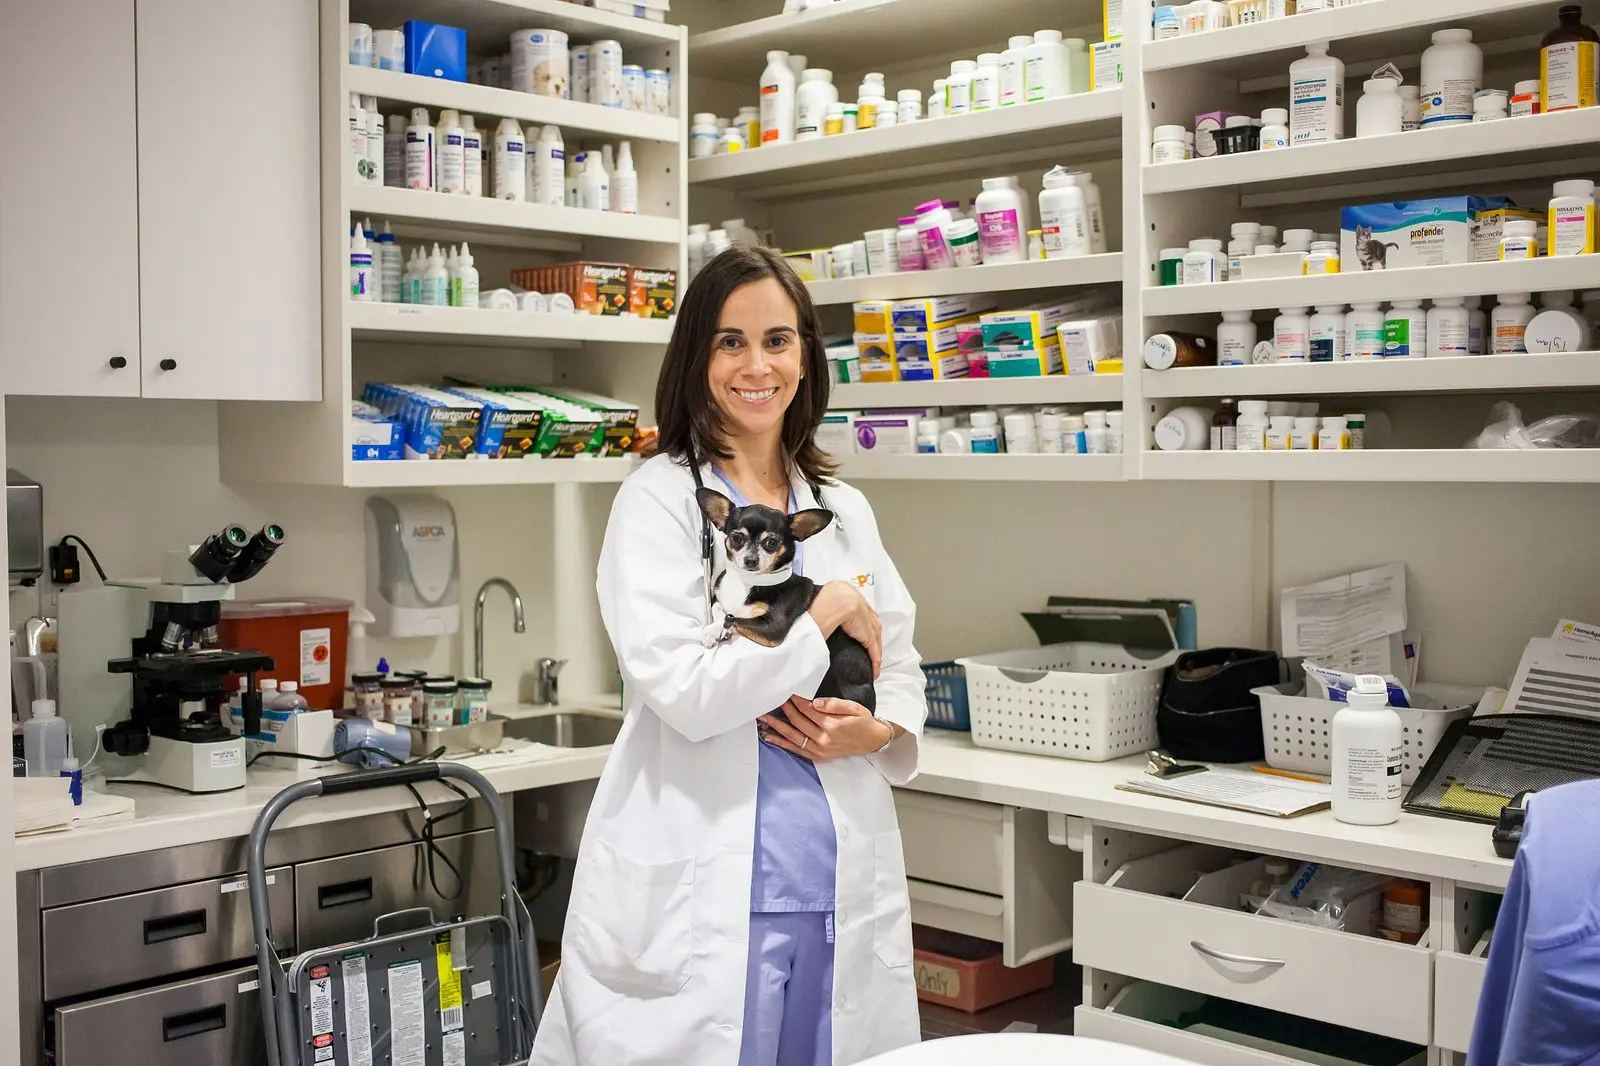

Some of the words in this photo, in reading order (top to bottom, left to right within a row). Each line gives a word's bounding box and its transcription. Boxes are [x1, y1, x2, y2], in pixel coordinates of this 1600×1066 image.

[1410, 226, 1444, 239] profender
[583, 265, 621, 280] Heartgard
[634, 270, 670, 284] Heartgard
[430, 408, 474, 422] Heartgard
[493, 410, 533, 423] Heartgard
[551, 422, 592, 433] Heartgard
[412, 525, 445, 538] ASPCA
[918, 965, 948, 996] Only
